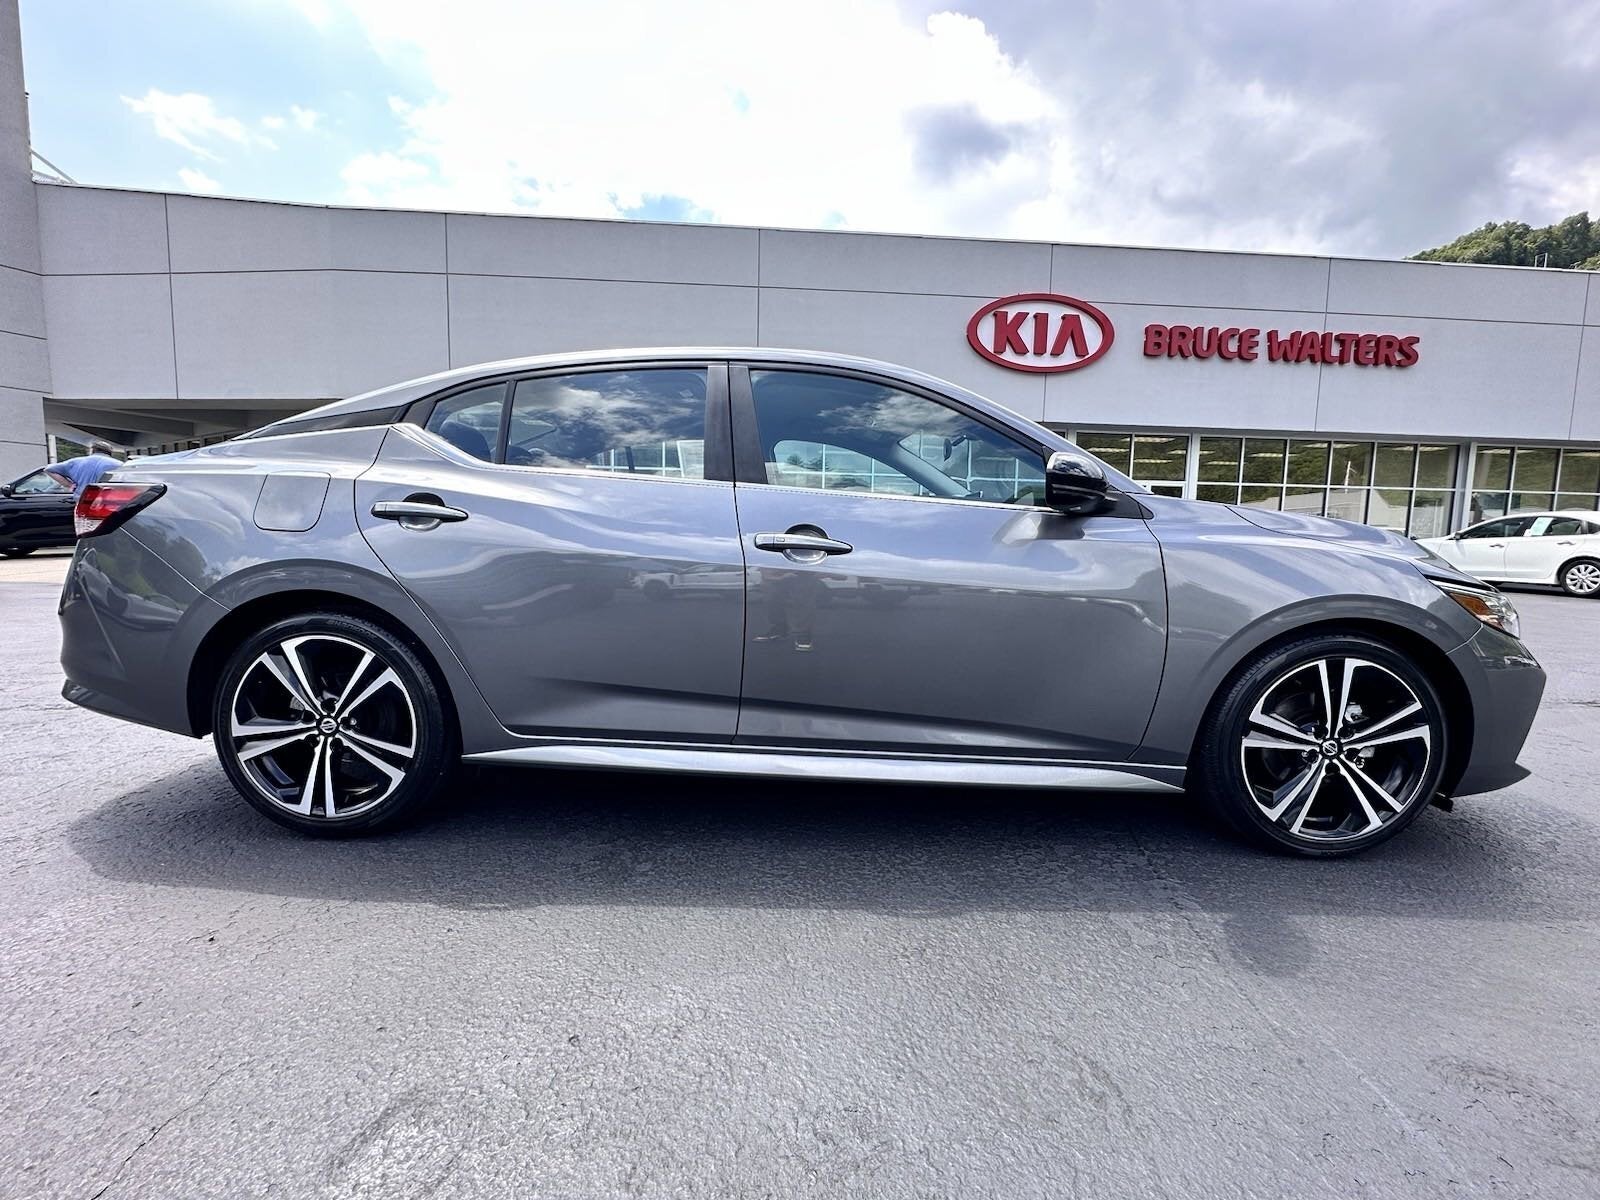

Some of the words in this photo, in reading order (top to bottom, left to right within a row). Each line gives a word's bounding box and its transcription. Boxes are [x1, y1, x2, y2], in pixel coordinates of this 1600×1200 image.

[993, 311, 1089, 357] KIA
[1144, 324, 1260, 360] BRUCE
[1266, 330, 1420, 367] WALTERS
